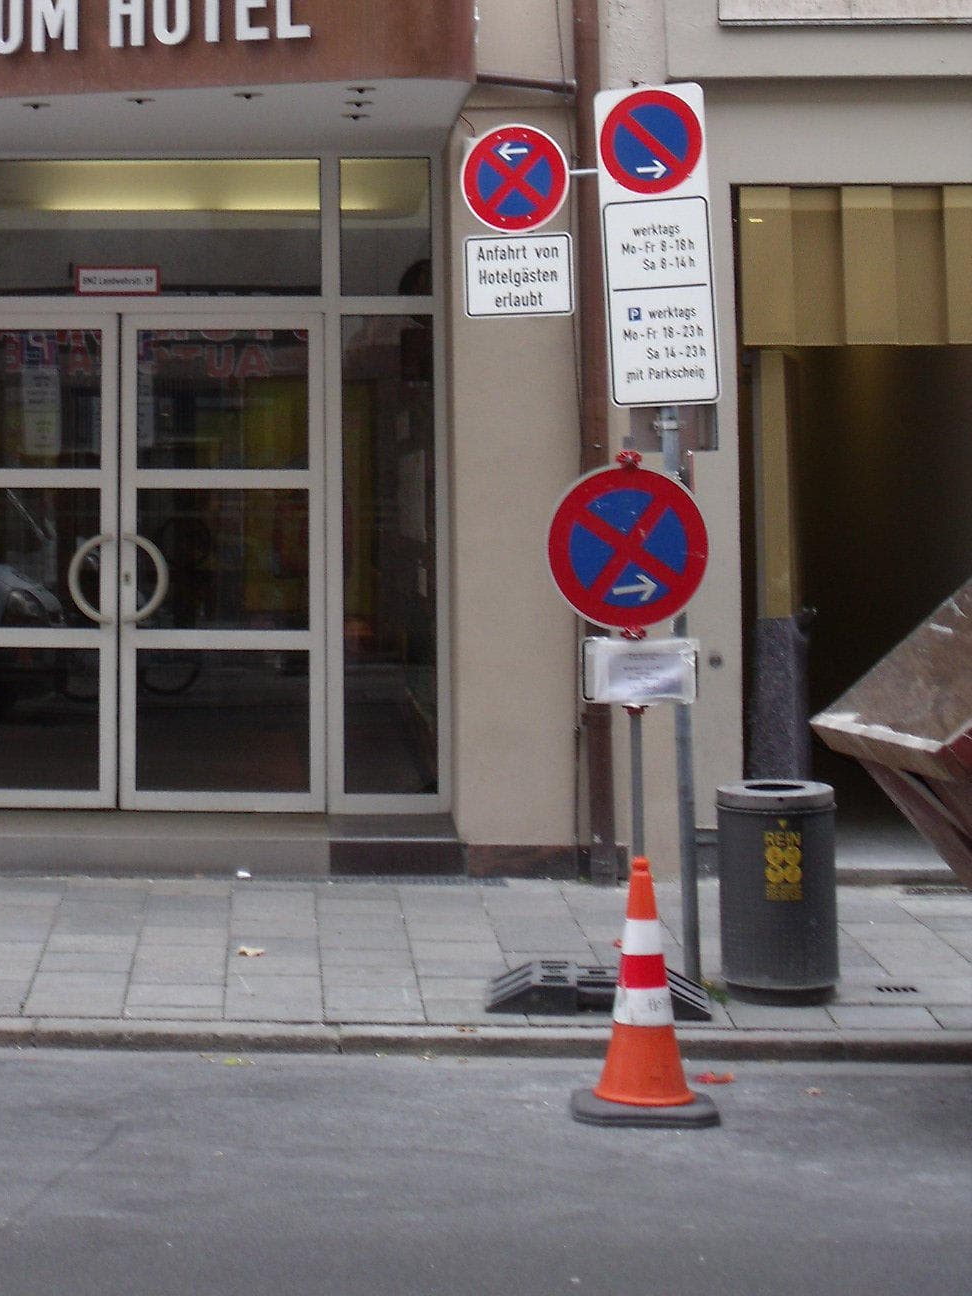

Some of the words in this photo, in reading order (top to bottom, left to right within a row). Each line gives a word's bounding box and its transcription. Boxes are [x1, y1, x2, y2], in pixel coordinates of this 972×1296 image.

[632, 224, 681, 238] werktags
[477, 245, 528, 261] Anfahrt
[535, 246, 559, 259] von
[642, 258, 656, 271] Sa
[479, 268, 558, 287] Hotelgästen
[495, 291, 544, 308] erlaubt
[648, 306, 697, 320] werktags
[646, 347, 660, 360] Sa
[627, 369, 644, 381] mit
[648, 365, 705, 380] Parkschein
